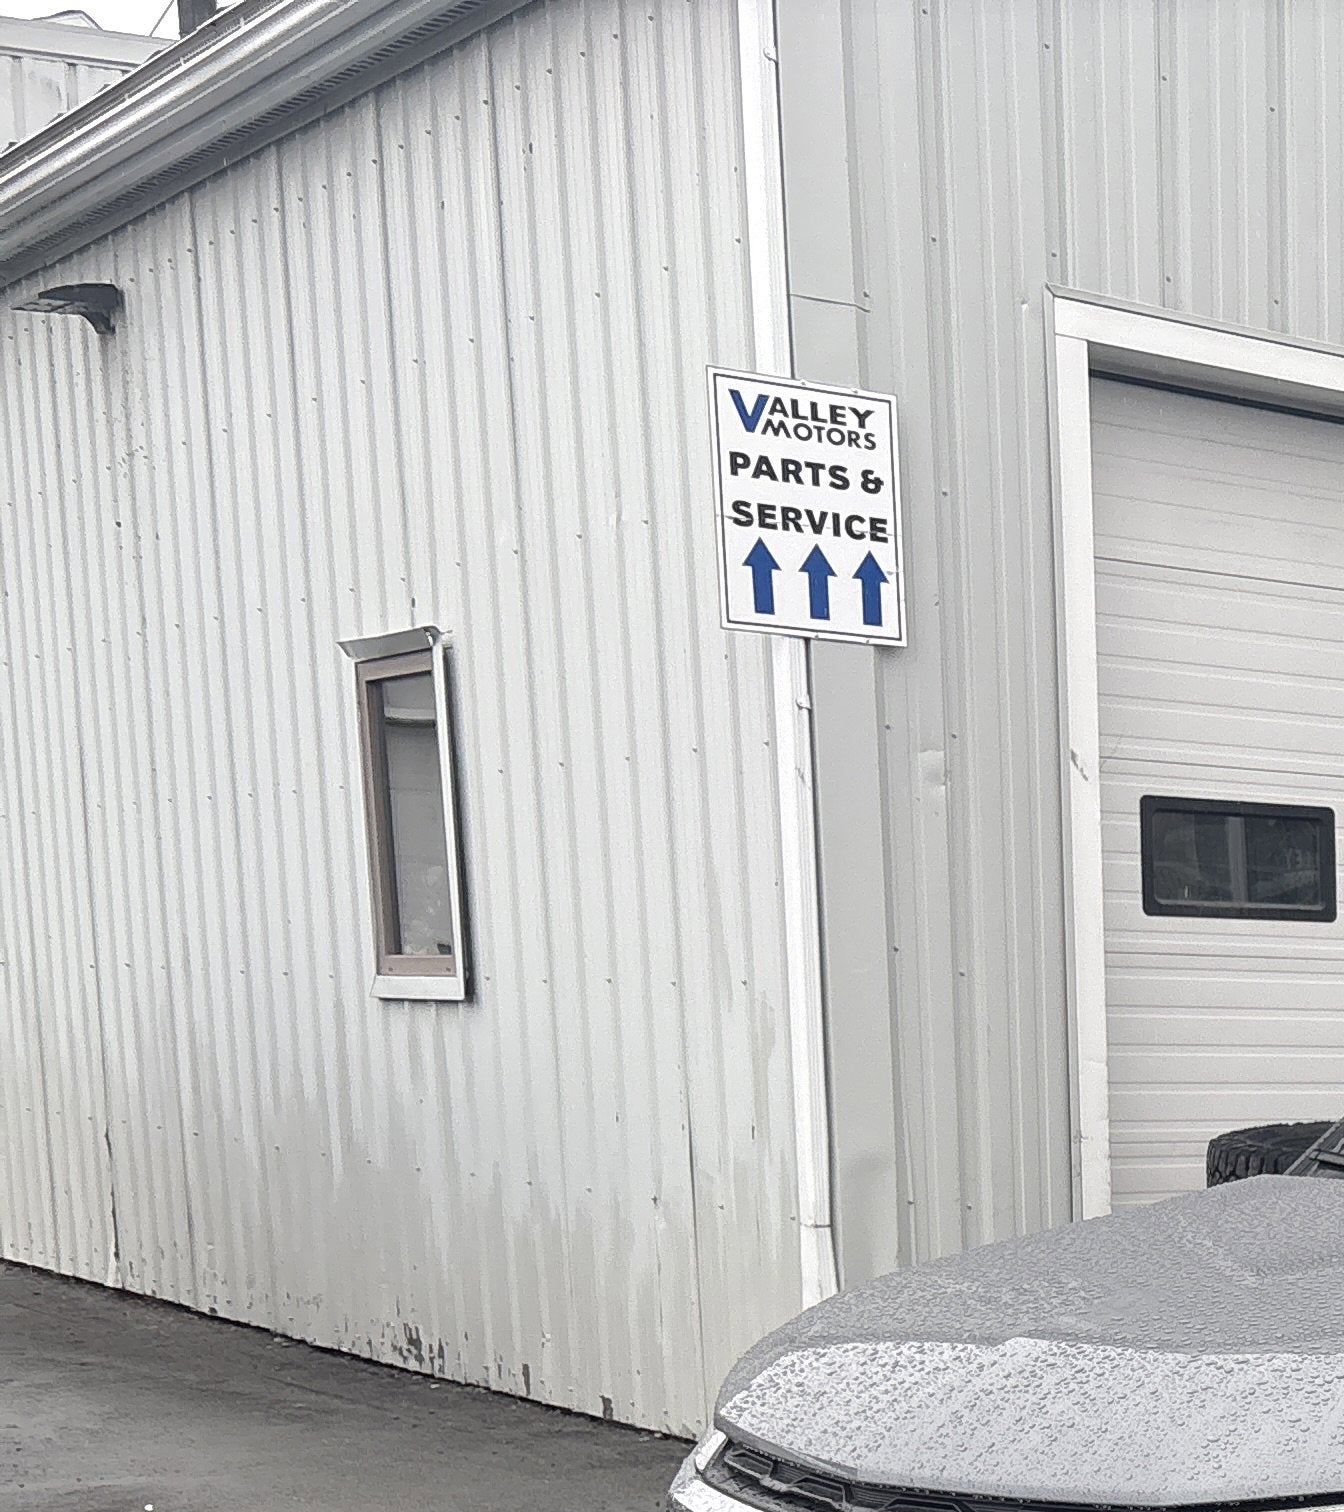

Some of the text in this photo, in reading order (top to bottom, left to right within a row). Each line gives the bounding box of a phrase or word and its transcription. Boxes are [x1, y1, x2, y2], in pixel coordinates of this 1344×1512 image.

[728, 388, 875, 433] VALLEY
[761, 418, 877, 450] MOTORS
[728, 451, 884, 494] PARTS &
[731, 500, 888, 543] SERVICE
